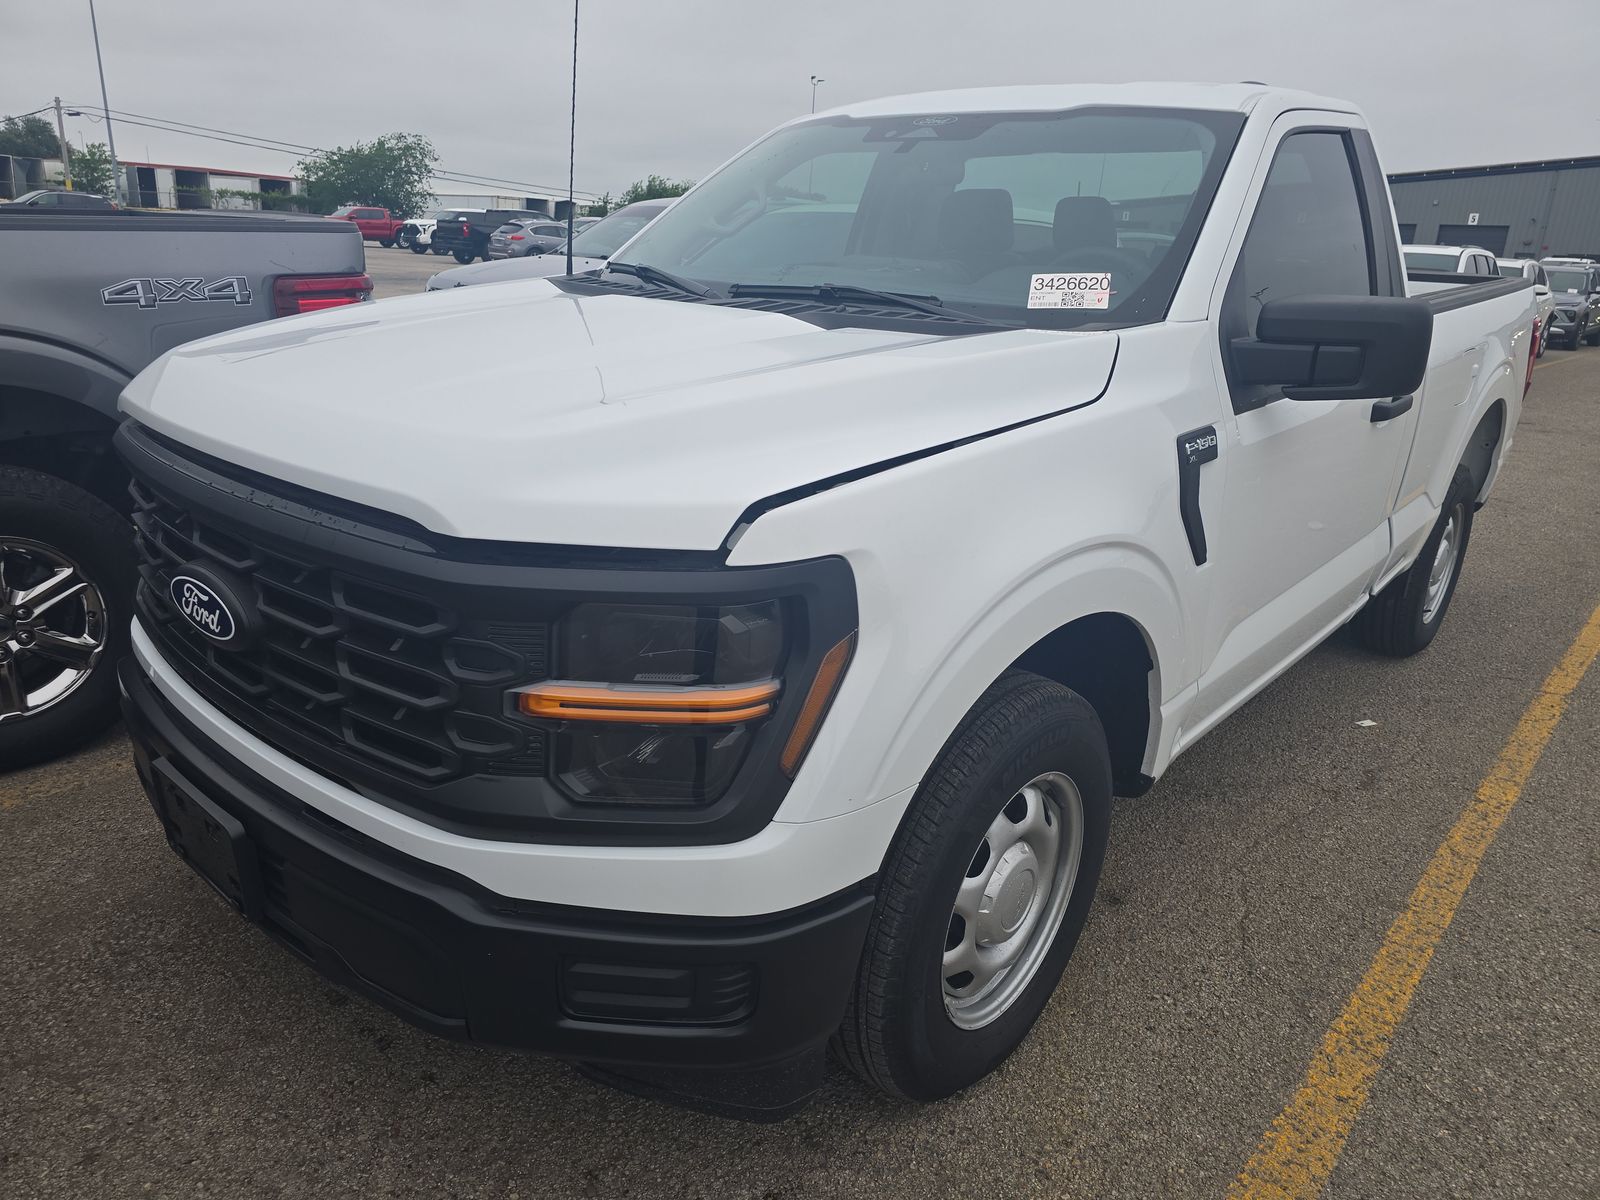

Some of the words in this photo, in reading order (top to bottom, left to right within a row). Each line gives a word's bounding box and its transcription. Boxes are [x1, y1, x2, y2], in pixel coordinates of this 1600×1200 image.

[1033, 276, 1110, 291] 3426620
[1185, 435, 1216, 455] F-150
[182, 583, 221, 633] Ford
